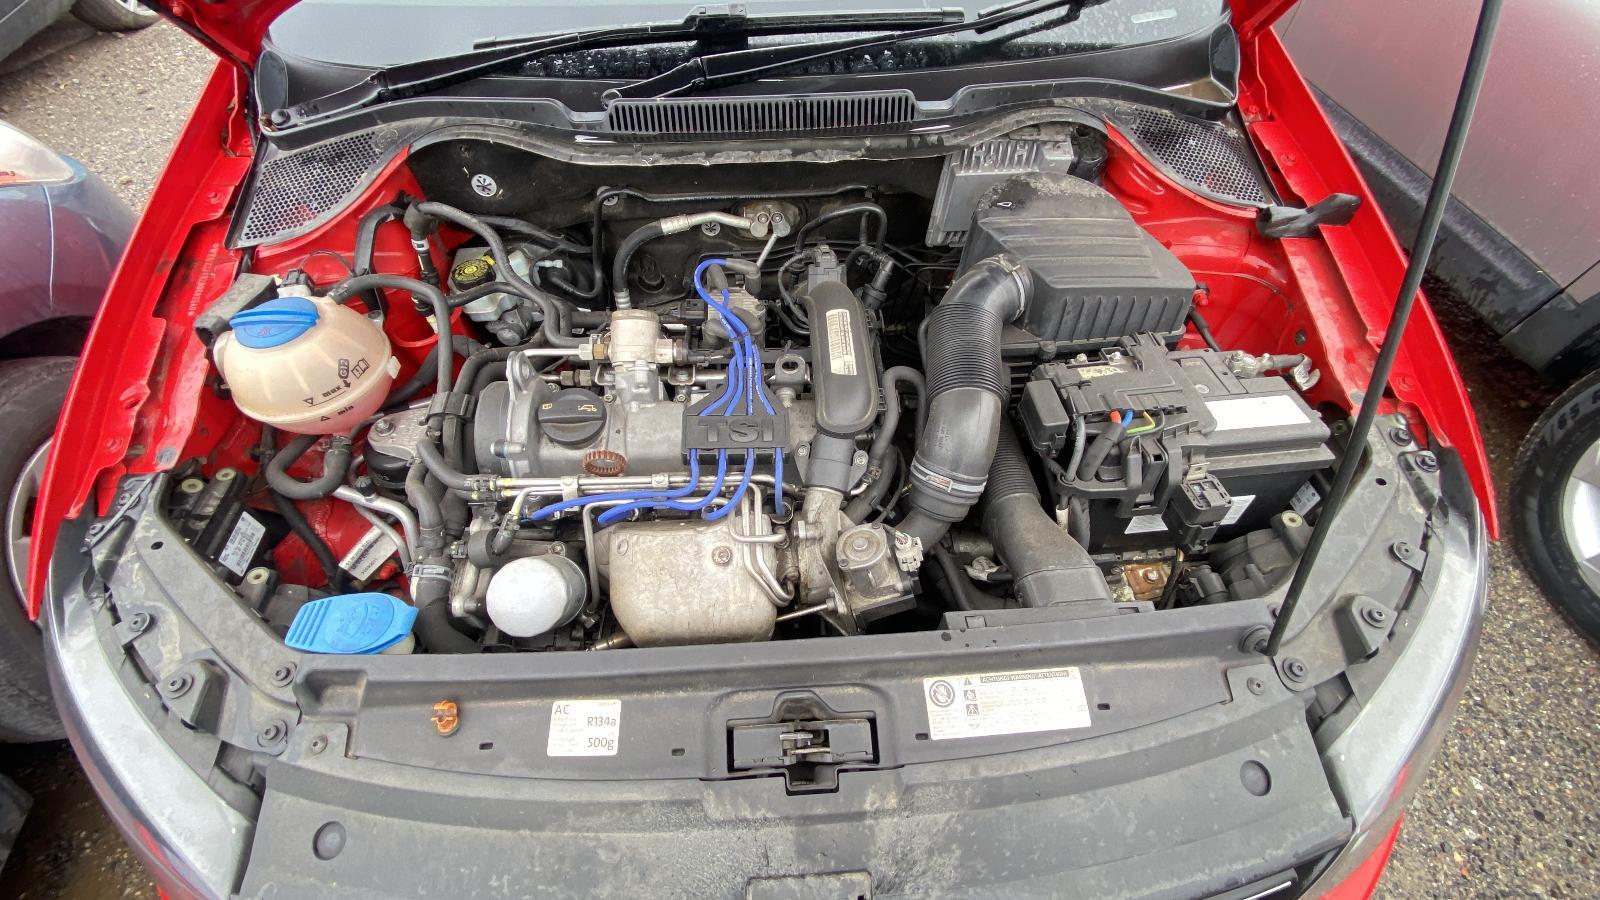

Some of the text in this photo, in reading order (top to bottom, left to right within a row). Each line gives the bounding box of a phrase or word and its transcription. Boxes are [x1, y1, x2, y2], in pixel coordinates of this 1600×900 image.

[322, 385, 342, 398] max
[337, 405, 354, 416] min
[697, 419, 775, 443] TSI
[554, 704, 570, 715] AC
[587, 716, 617, 727] R134a
[587, 737, 614, 751] 500g
